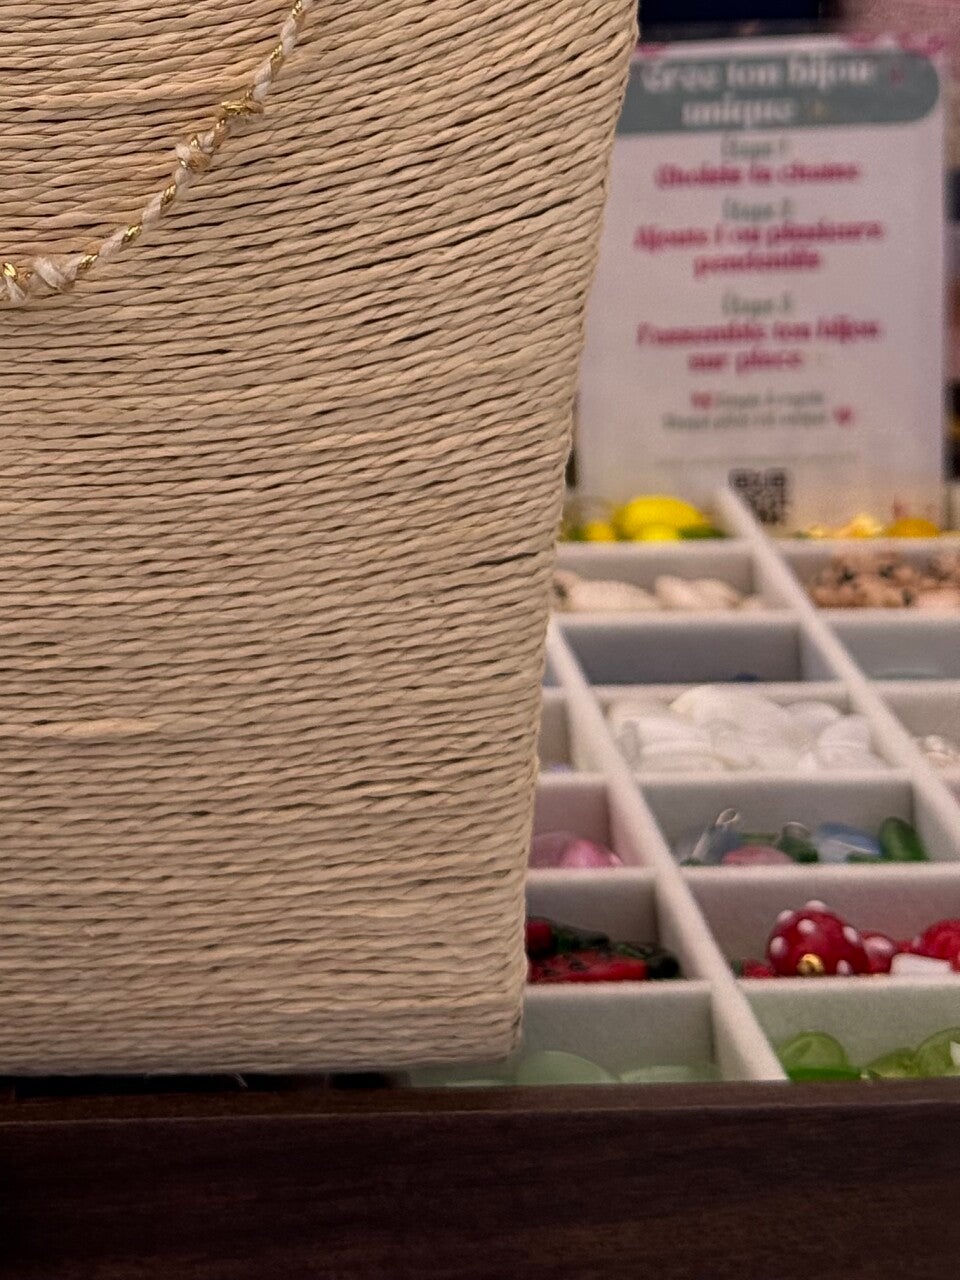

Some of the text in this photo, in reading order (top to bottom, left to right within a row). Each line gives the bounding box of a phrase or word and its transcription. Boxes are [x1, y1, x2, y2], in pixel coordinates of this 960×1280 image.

[726, 61, 779, 88] ton
[788, 55, 873, 91] bijou
[682, 93, 795, 131] unique
